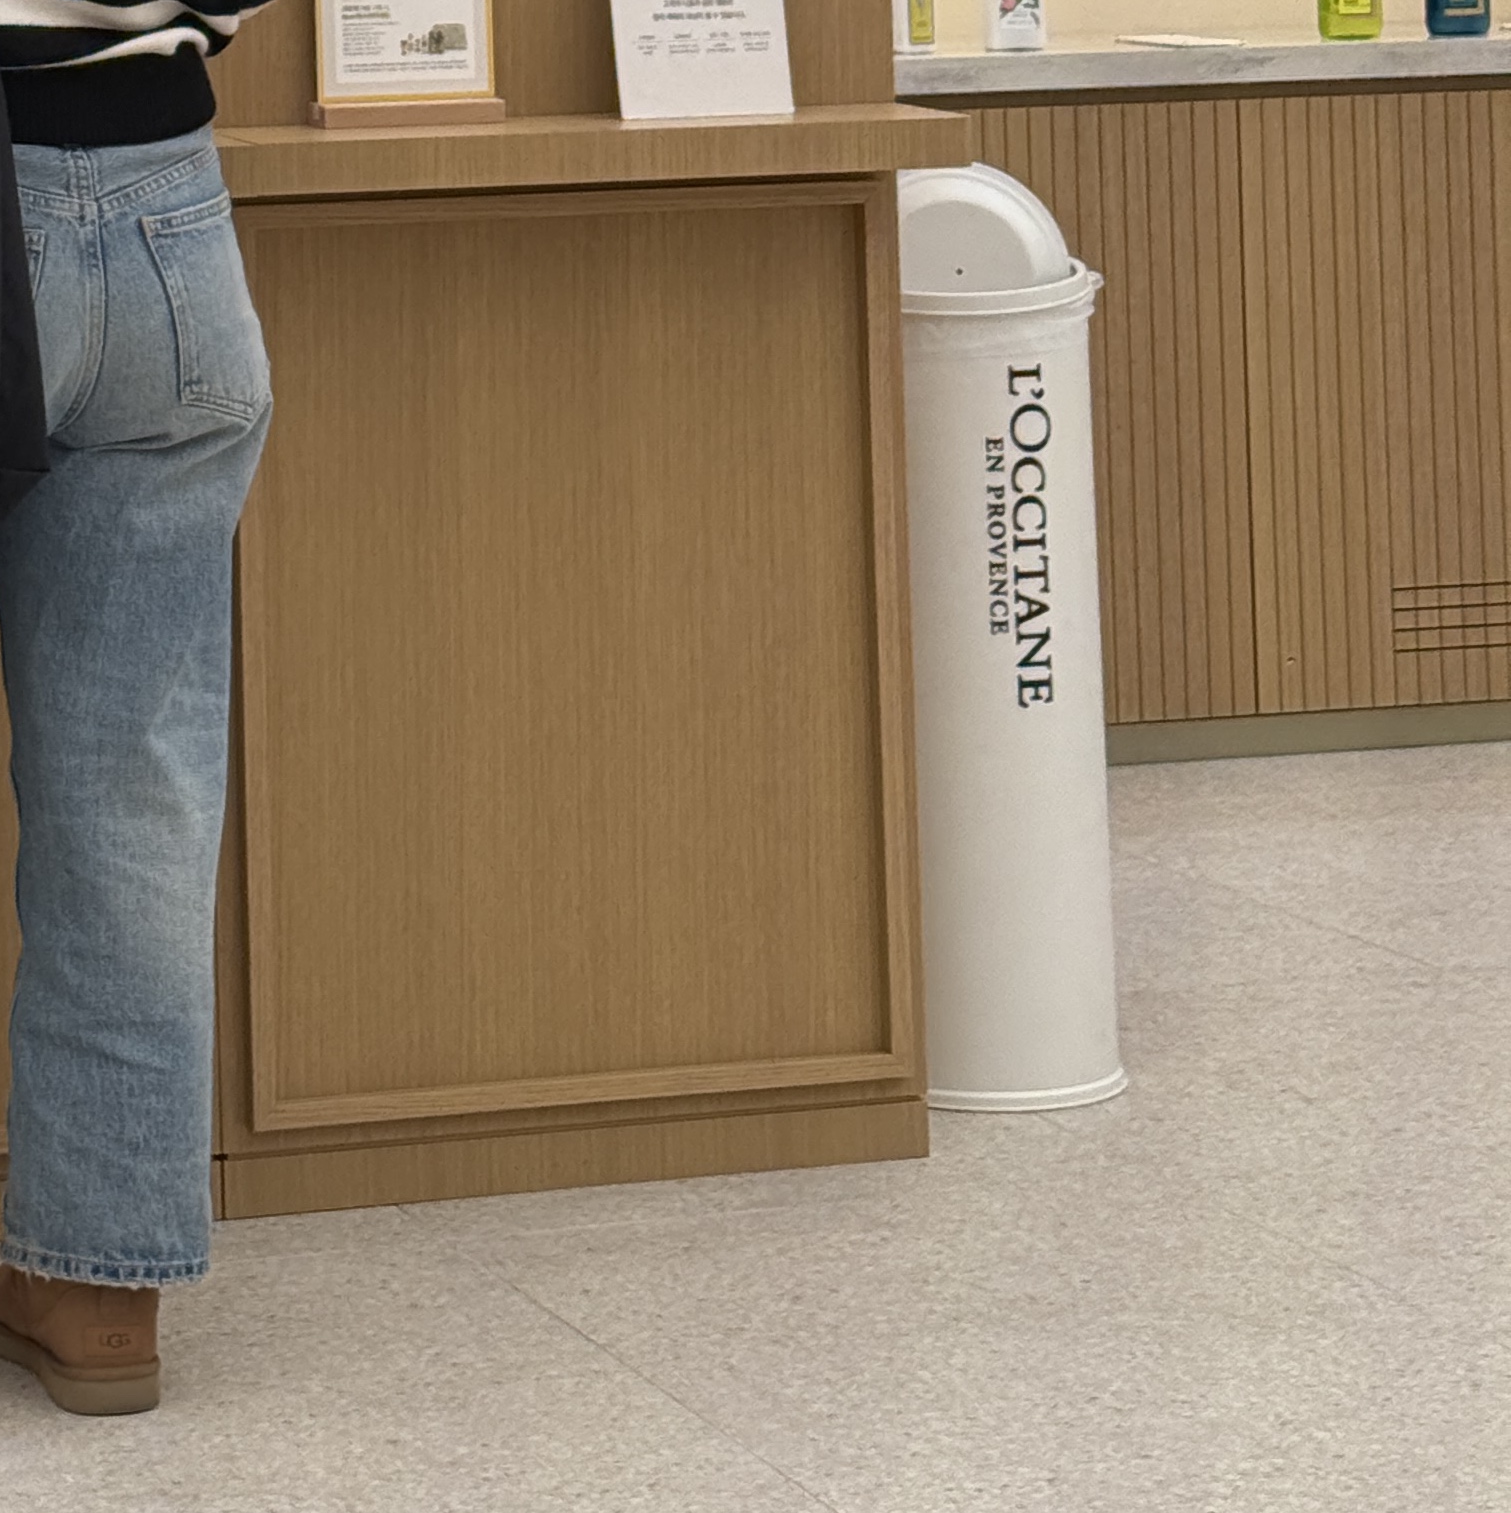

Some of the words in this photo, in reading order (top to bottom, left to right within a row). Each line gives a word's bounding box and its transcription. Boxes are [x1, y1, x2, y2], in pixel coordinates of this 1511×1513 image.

[985, 437, 1005, 473] EN
[986, 484, 1010, 636] PROVENCE
[1007, 363, 1054, 709] L'OCCITANE
[98, 1333, 131, 1349] UGG
